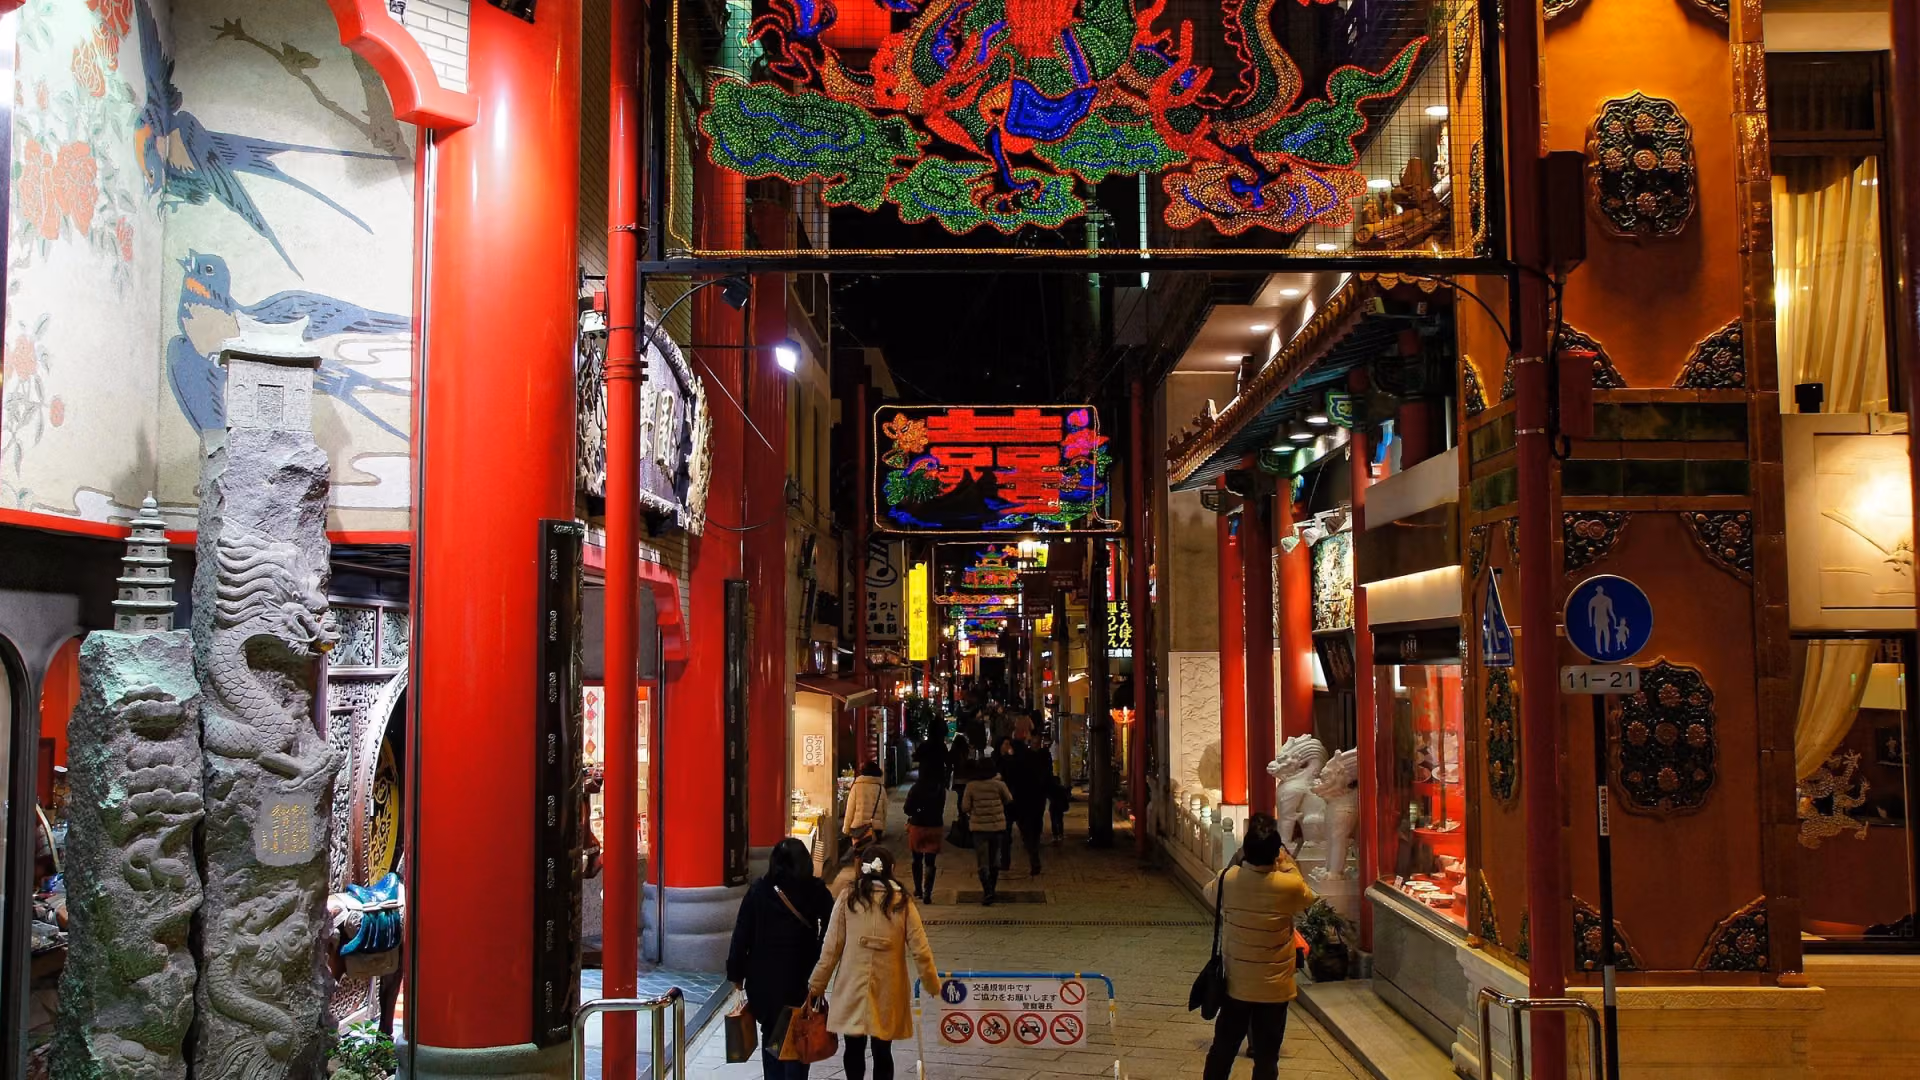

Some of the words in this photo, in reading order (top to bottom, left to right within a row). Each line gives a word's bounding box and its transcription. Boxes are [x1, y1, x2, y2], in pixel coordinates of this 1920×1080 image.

[1107, 601, 1119, 648] 皿うどん
[1119, 601, 1132, 648] ちゃんぽん
[1567, 671, 1633, 688] 11-21
[972, 983, 1032, 992] 交通規制中です
[973, 993, 1058, 1002] ご協力をお願いします
[1022, 1002, 1053, 1010] 警察署長
